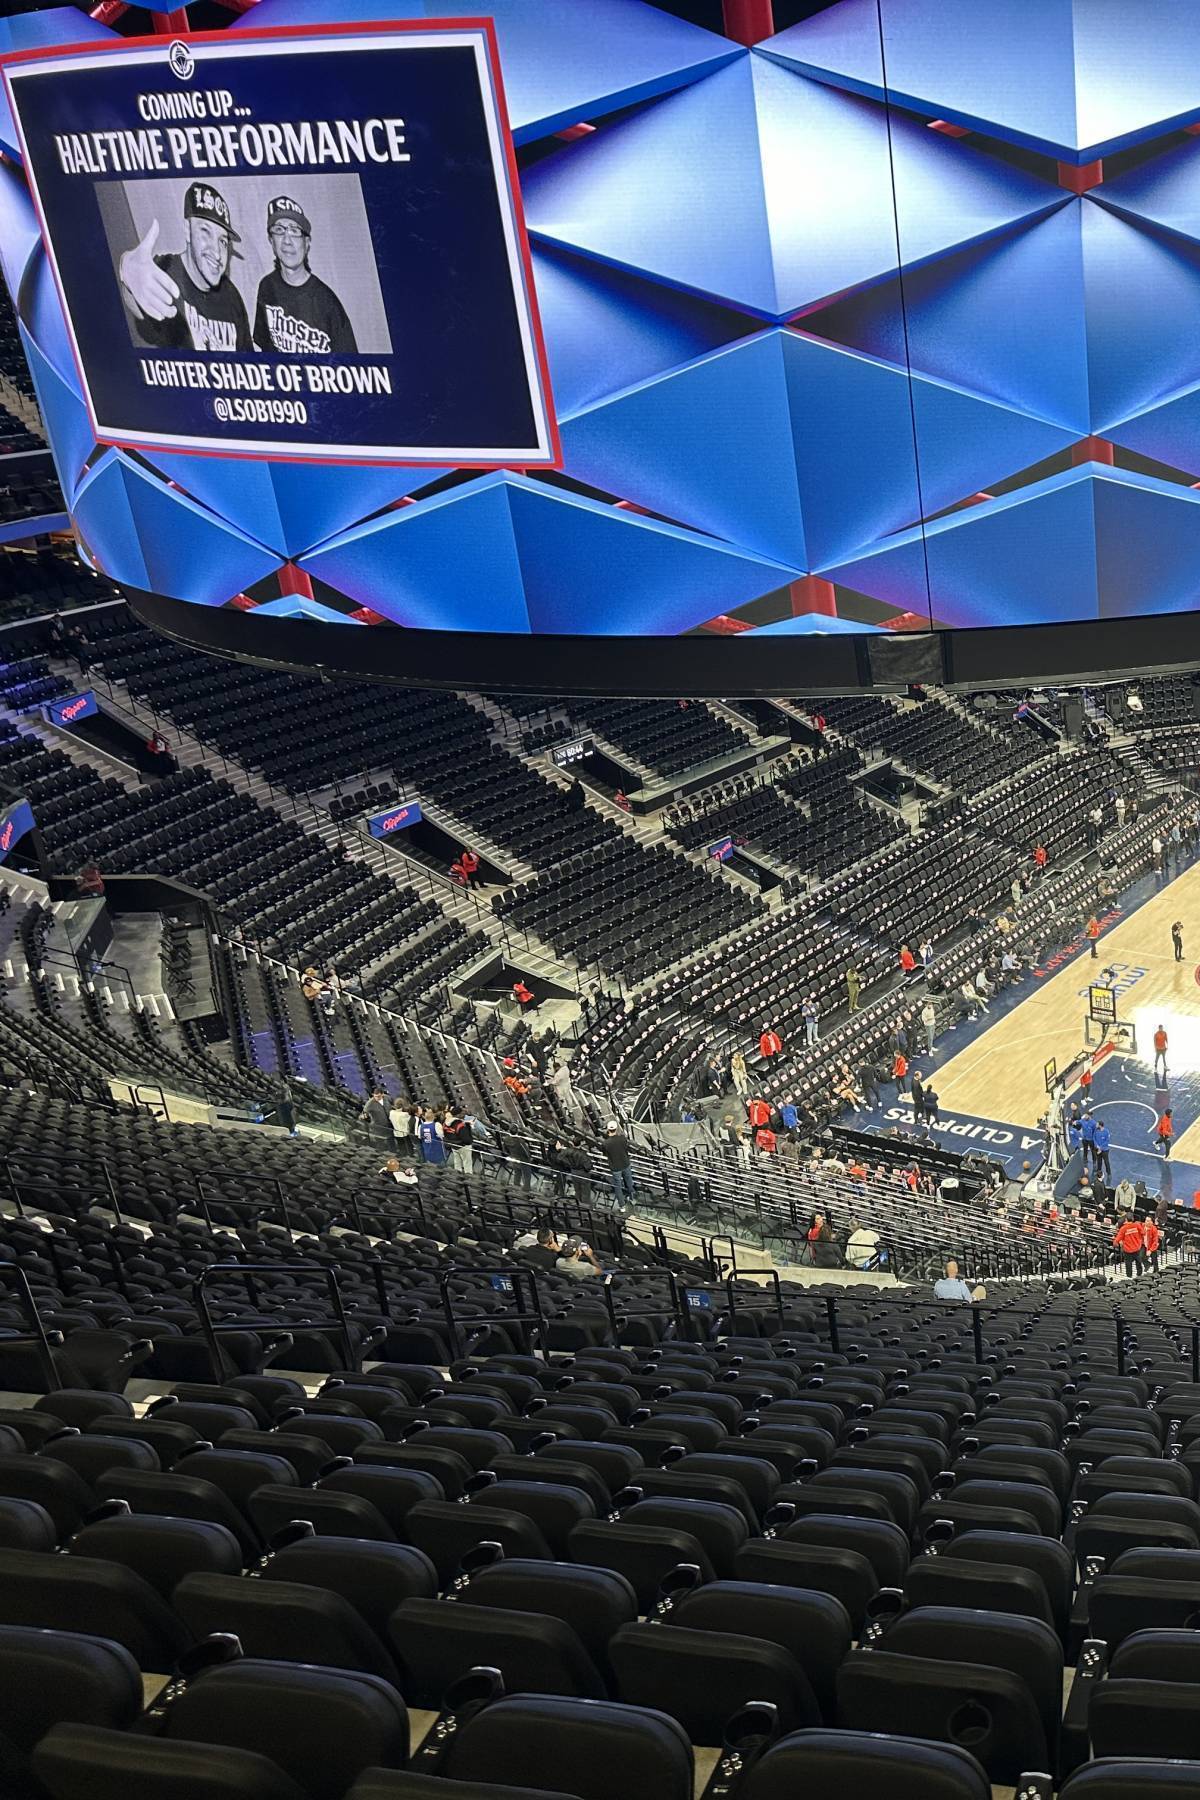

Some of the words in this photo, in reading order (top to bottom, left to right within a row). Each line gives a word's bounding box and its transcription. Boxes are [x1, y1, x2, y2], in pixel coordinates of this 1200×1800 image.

[138, 91, 207, 121] COMING
[54, 128, 169, 174] HALFTIME
[166, 118, 412, 169] PERFORMANCE
[140, 359, 211, 389] LIGHTER
[210, 363, 275, 392] SHADE
[276, 365, 302, 392] OF
[305, 365, 393, 394] BROWN
[214, 397, 308, 425] @LSOB1990
[61, 699, 87, 720] Clippers
[383, 809, 409, 830] Clippers
[501, 1282, 514, 1291] 15
[687, 1297, 701, 1307] 15
